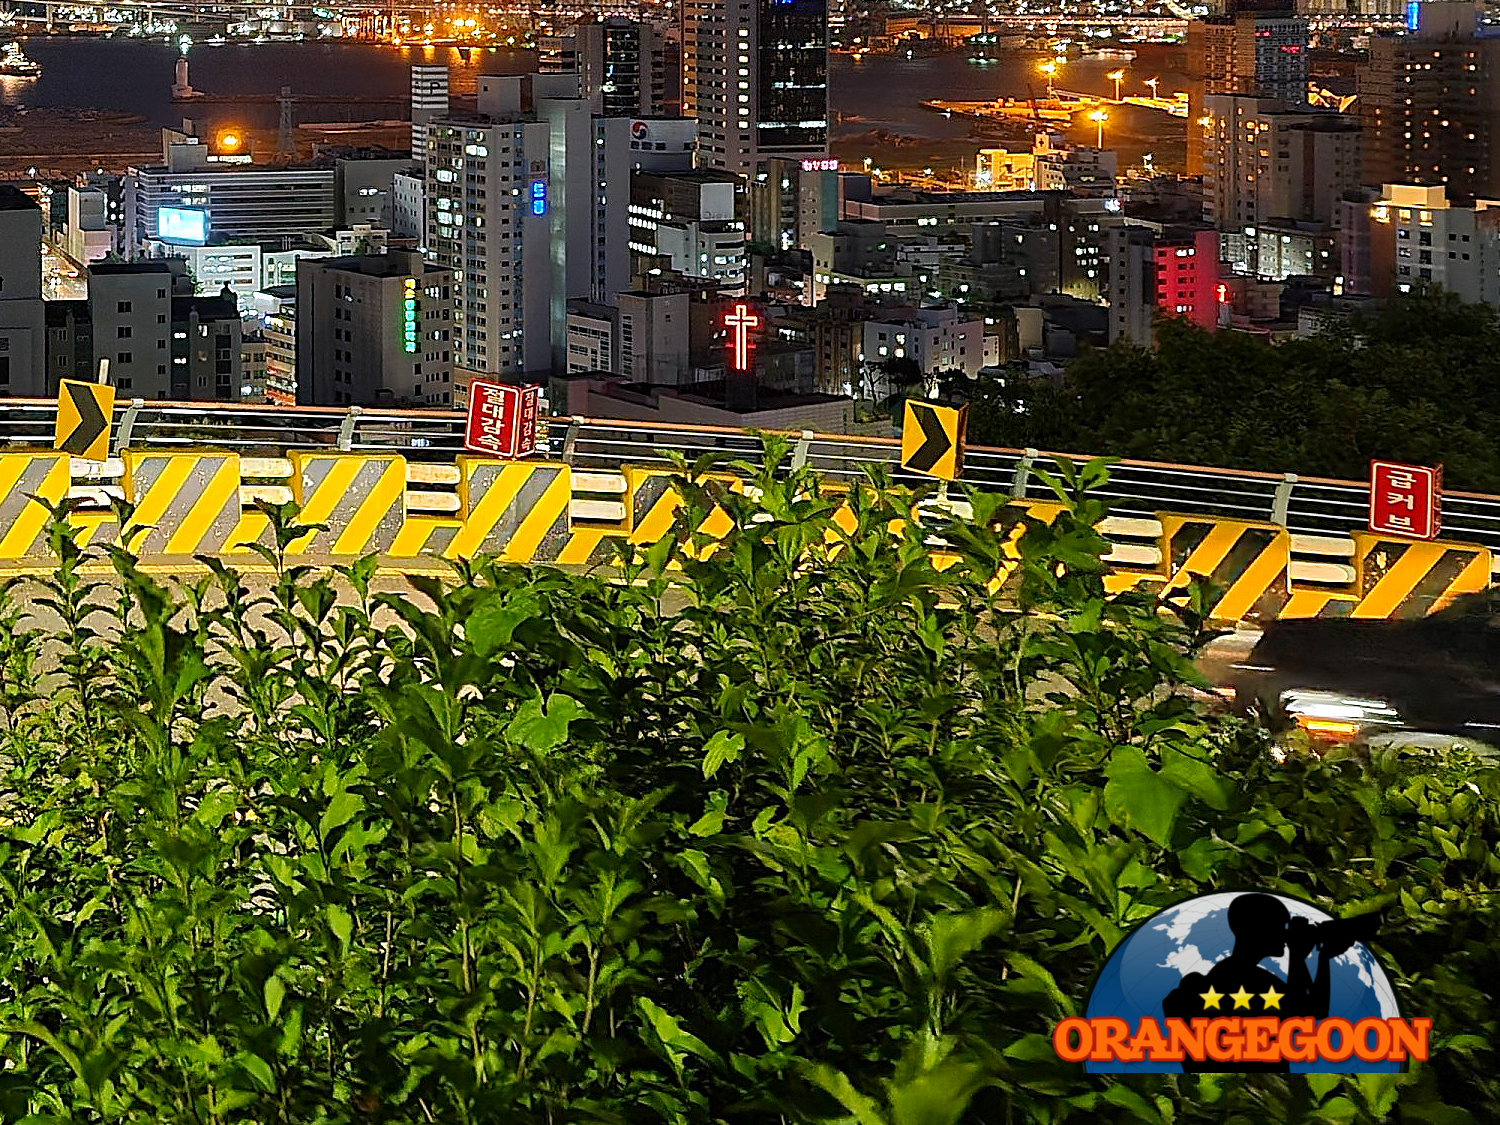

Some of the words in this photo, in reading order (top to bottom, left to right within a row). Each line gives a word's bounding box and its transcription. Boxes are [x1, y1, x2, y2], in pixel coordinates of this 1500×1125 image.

[429, 81, 441, 95] P
[477, 387, 506, 451] 절대감속
[521, 391, 535, 451] 절대감속
[1383, 470, 1418, 532] 급커브
